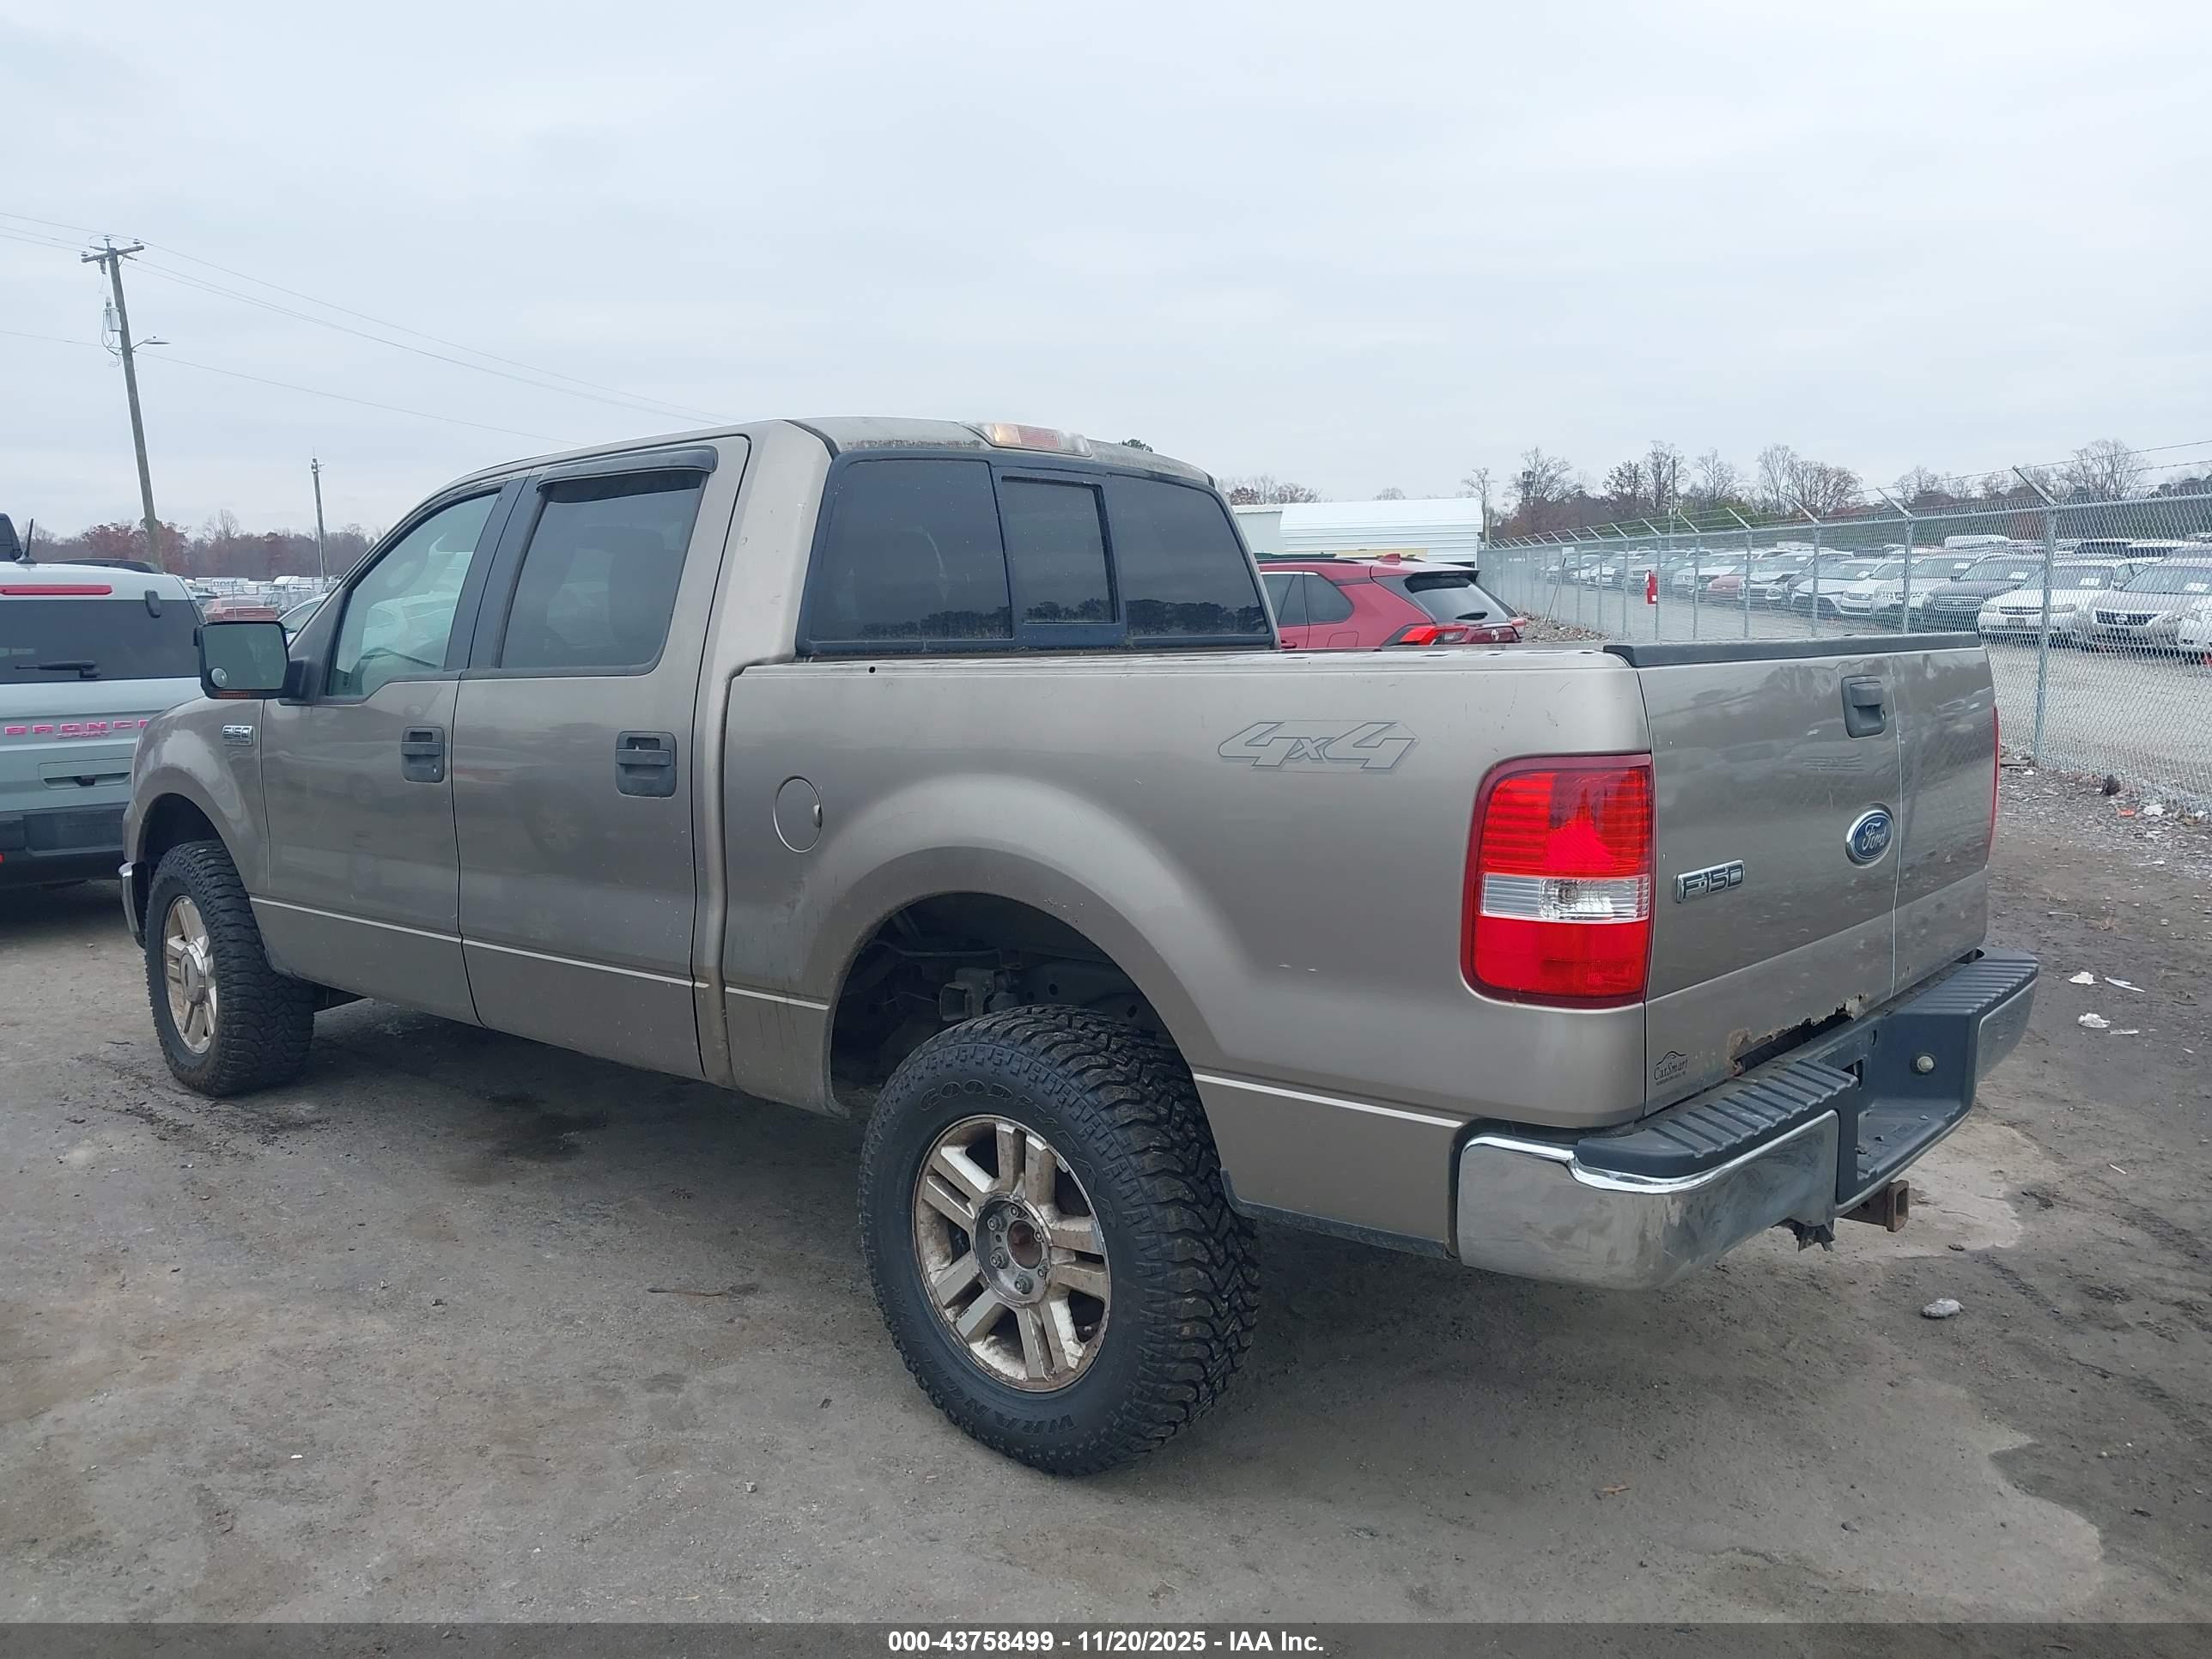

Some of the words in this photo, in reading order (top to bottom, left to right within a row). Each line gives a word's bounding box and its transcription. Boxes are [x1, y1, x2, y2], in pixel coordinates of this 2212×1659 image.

[55, 730, 112, 739] SPORT
[1218, 721, 1417, 769] 4x4
[1862, 821, 1887, 851] Ford
